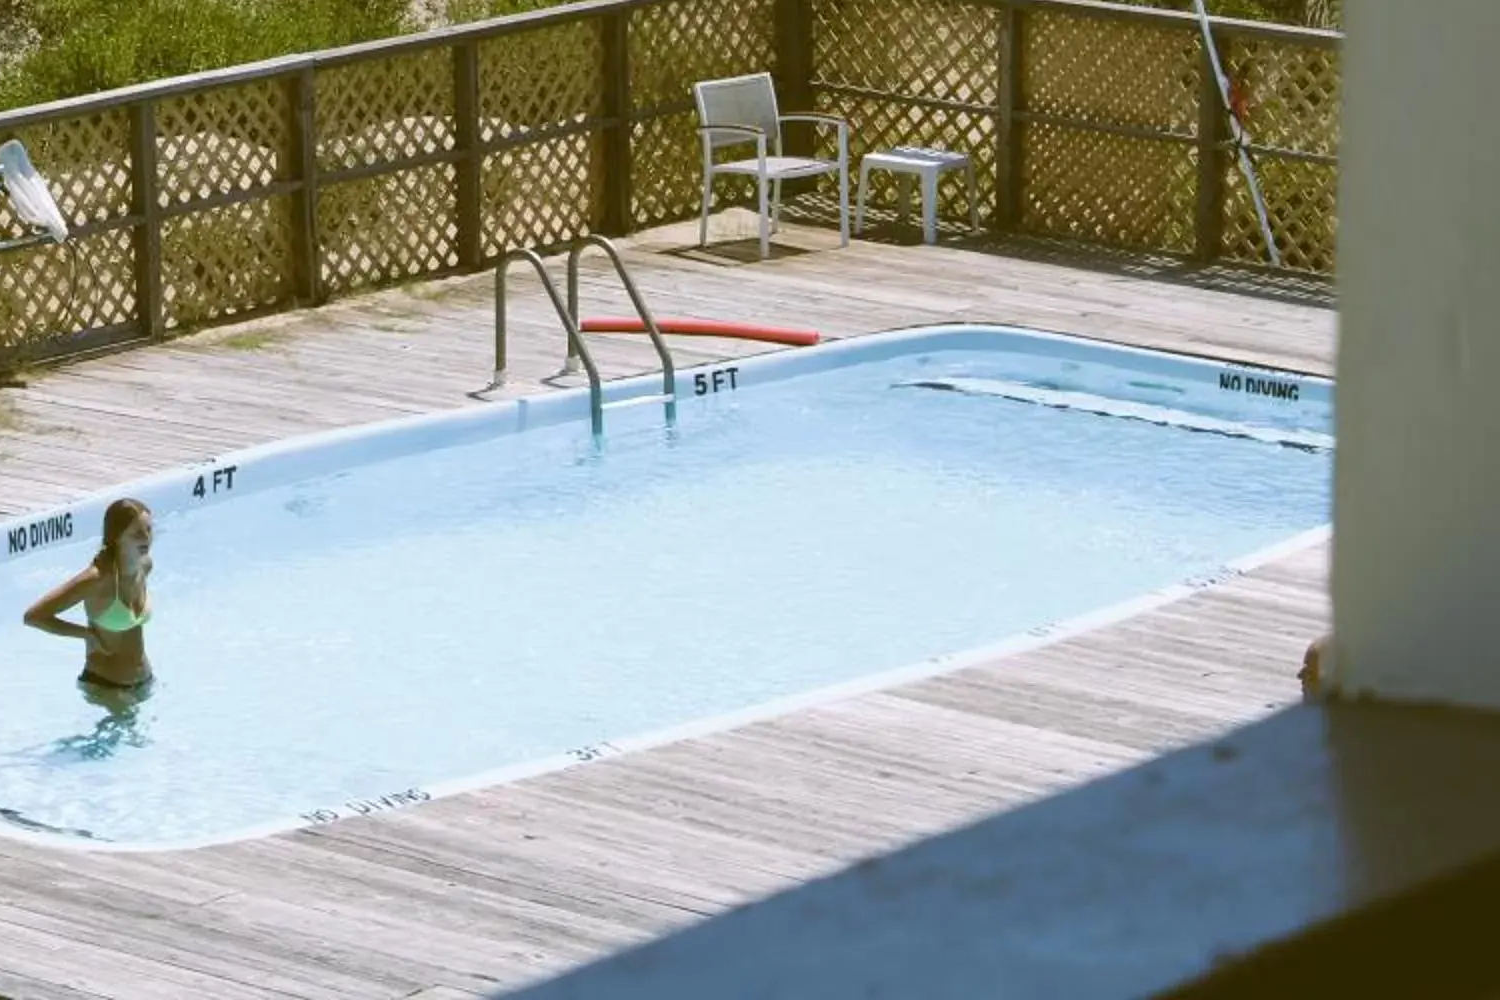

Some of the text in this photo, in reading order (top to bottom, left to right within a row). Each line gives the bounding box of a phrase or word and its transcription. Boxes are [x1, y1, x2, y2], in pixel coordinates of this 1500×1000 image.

[694, 367, 739, 396] 5 FT
[1219, 372, 1300, 400] NO DIVING
[193, 463, 237, 499] 4 FT
[8, 511, 73, 554] NO DIVING
